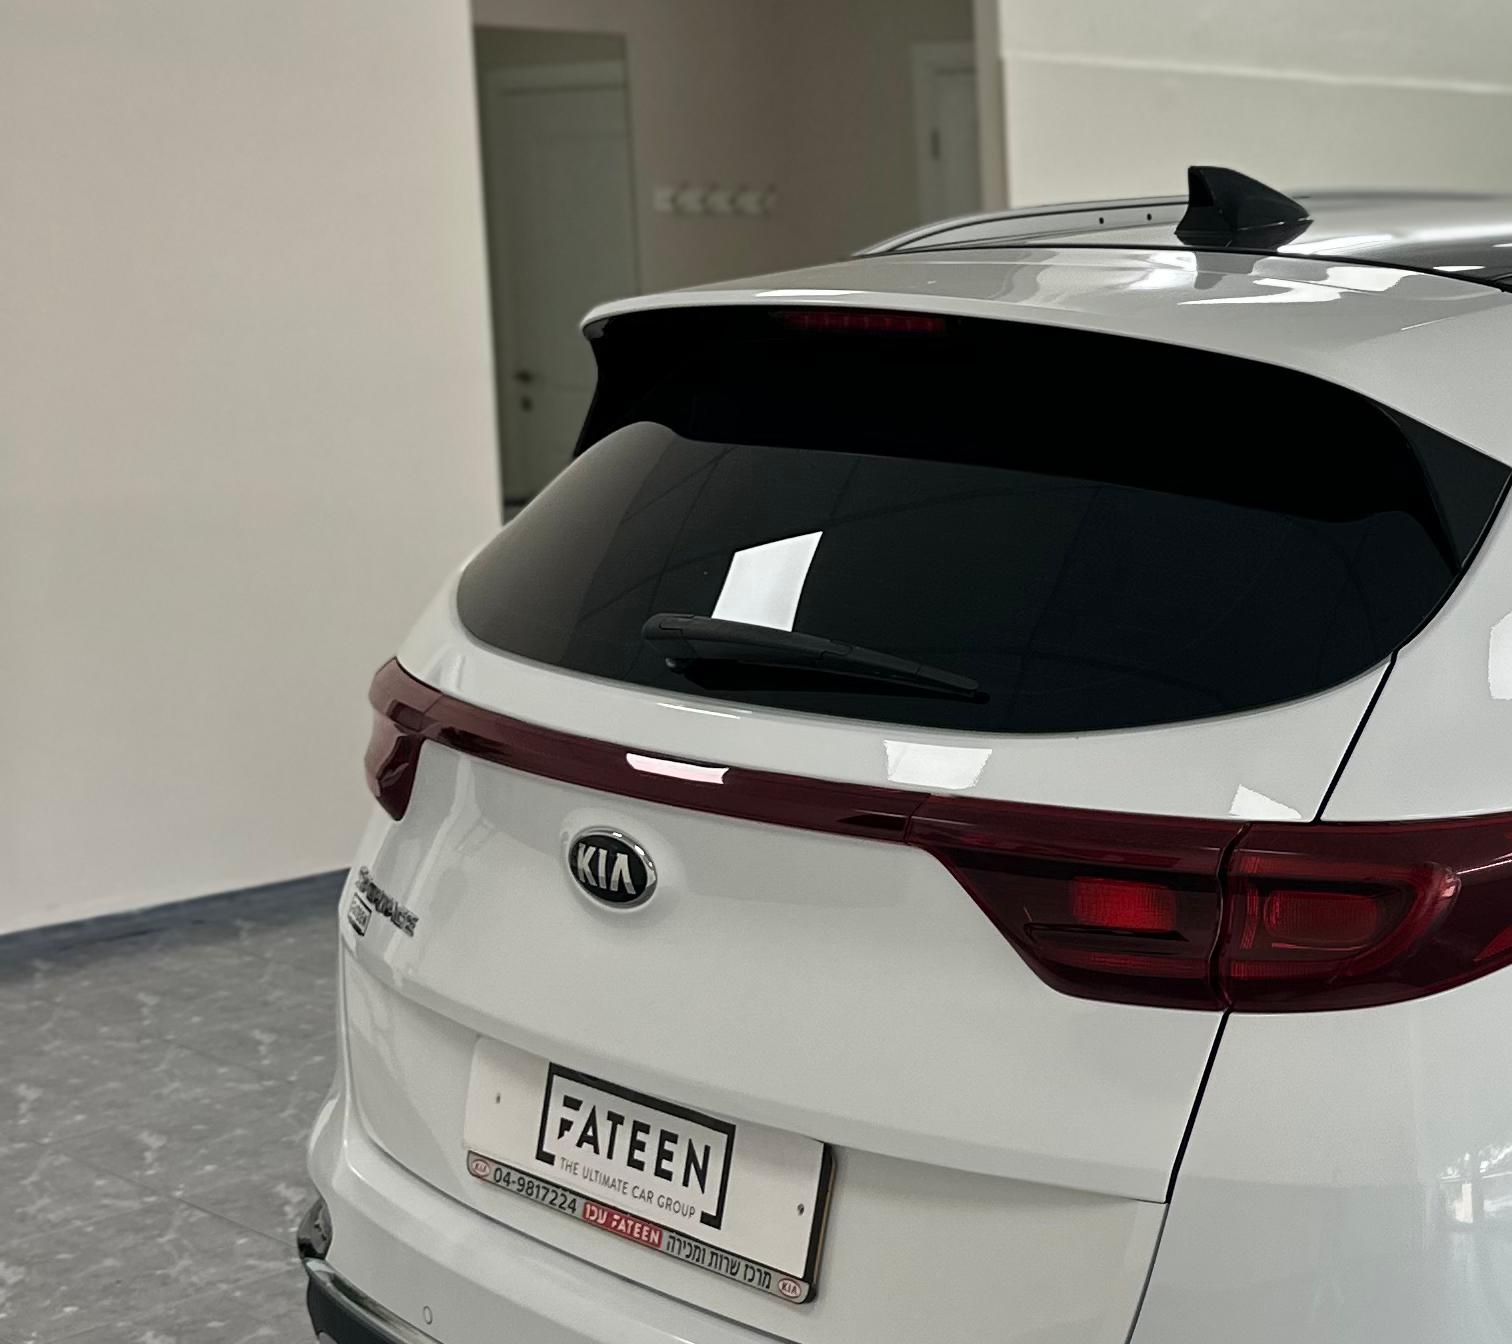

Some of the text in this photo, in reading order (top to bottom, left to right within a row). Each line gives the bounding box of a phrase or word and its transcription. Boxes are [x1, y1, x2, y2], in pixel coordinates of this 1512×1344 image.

[577, 842, 636, 895] KIA
[557, 1095, 711, 1194] FATEEN
[560, 1156, 696, 1218] THE ULTIMATE CAR GROUP
[494, 1167, 772, 1289] מרכז שרות ומכירה FATEEN עכו 04-9817224
